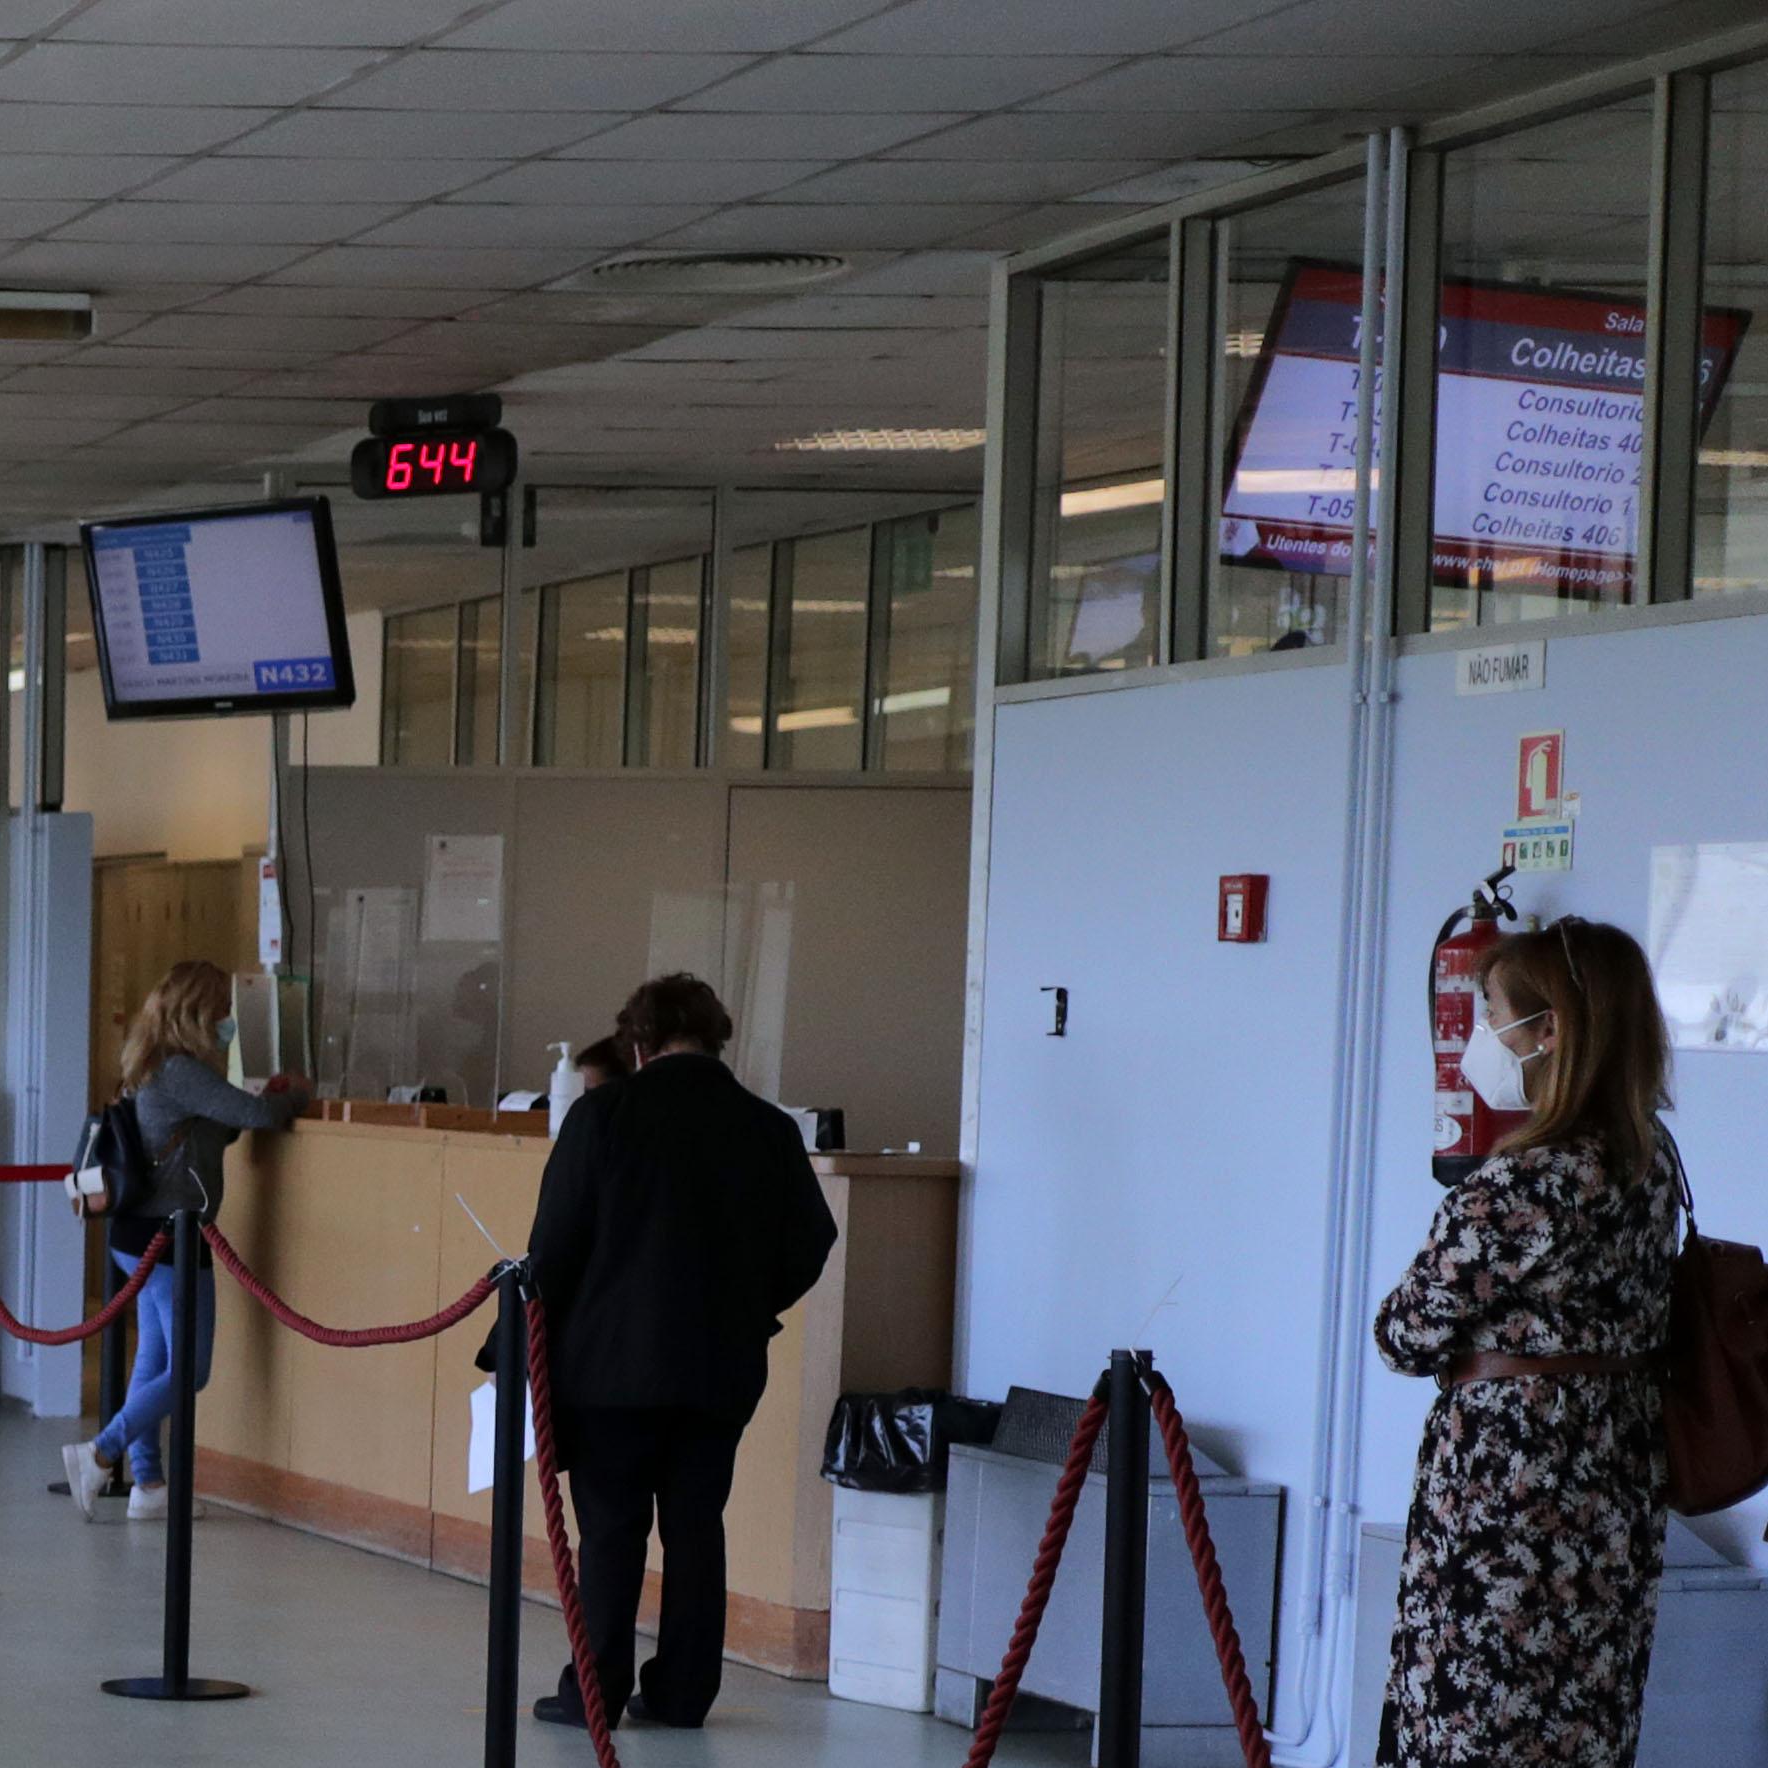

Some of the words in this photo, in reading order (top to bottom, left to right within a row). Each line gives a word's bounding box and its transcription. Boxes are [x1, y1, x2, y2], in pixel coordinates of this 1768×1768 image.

[1605, 312, 1644, 333] Sala
[1511, 338, 1646, 379] Colheitas
[1507, 420, 1611, 451] Colheitas
[1618, 432, 1643, 454] 40
[386, 440, 477, 491] 644
[1495, 451, 1625, 484] Consultorio
[1484, 482, 1613, 514] Consultorio
[1623, 496, 1633, 516] 1
[1472, 512, 1574, 542] Colheitas
[1582, 522, 1621, 546] 406
[1266, 535, 1327, 557] Utentes
[1330, 541, 1351, 558] do
[261, 663, 328, 684] N432
[1468, 652, 1491, 686] NÃO
[1492, 653, 1530, 684] FUMAR
